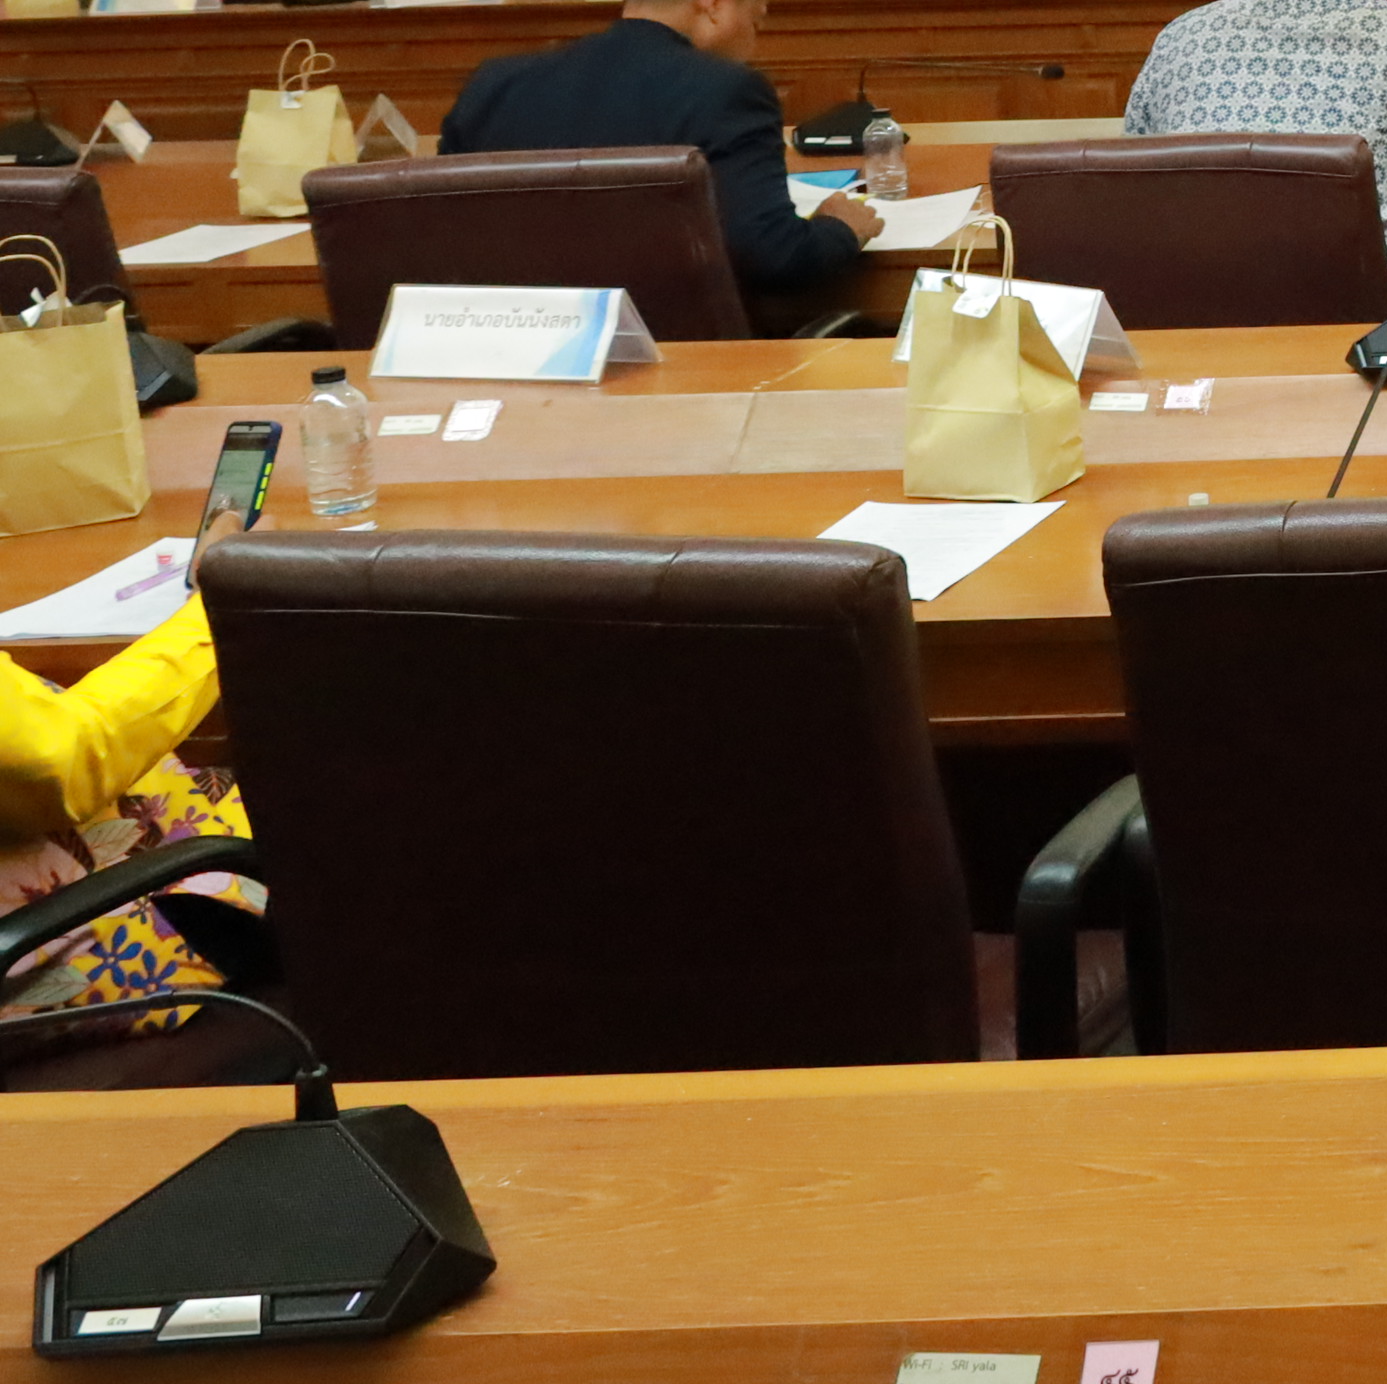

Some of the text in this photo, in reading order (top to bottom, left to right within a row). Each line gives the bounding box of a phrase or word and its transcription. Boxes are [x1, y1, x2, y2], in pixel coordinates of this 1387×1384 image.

[903, 1358, 932, 1371] Wi-Fi
[951, 1359, 969, 1371] SRI
[972, 1361, 996, 1373] yala
